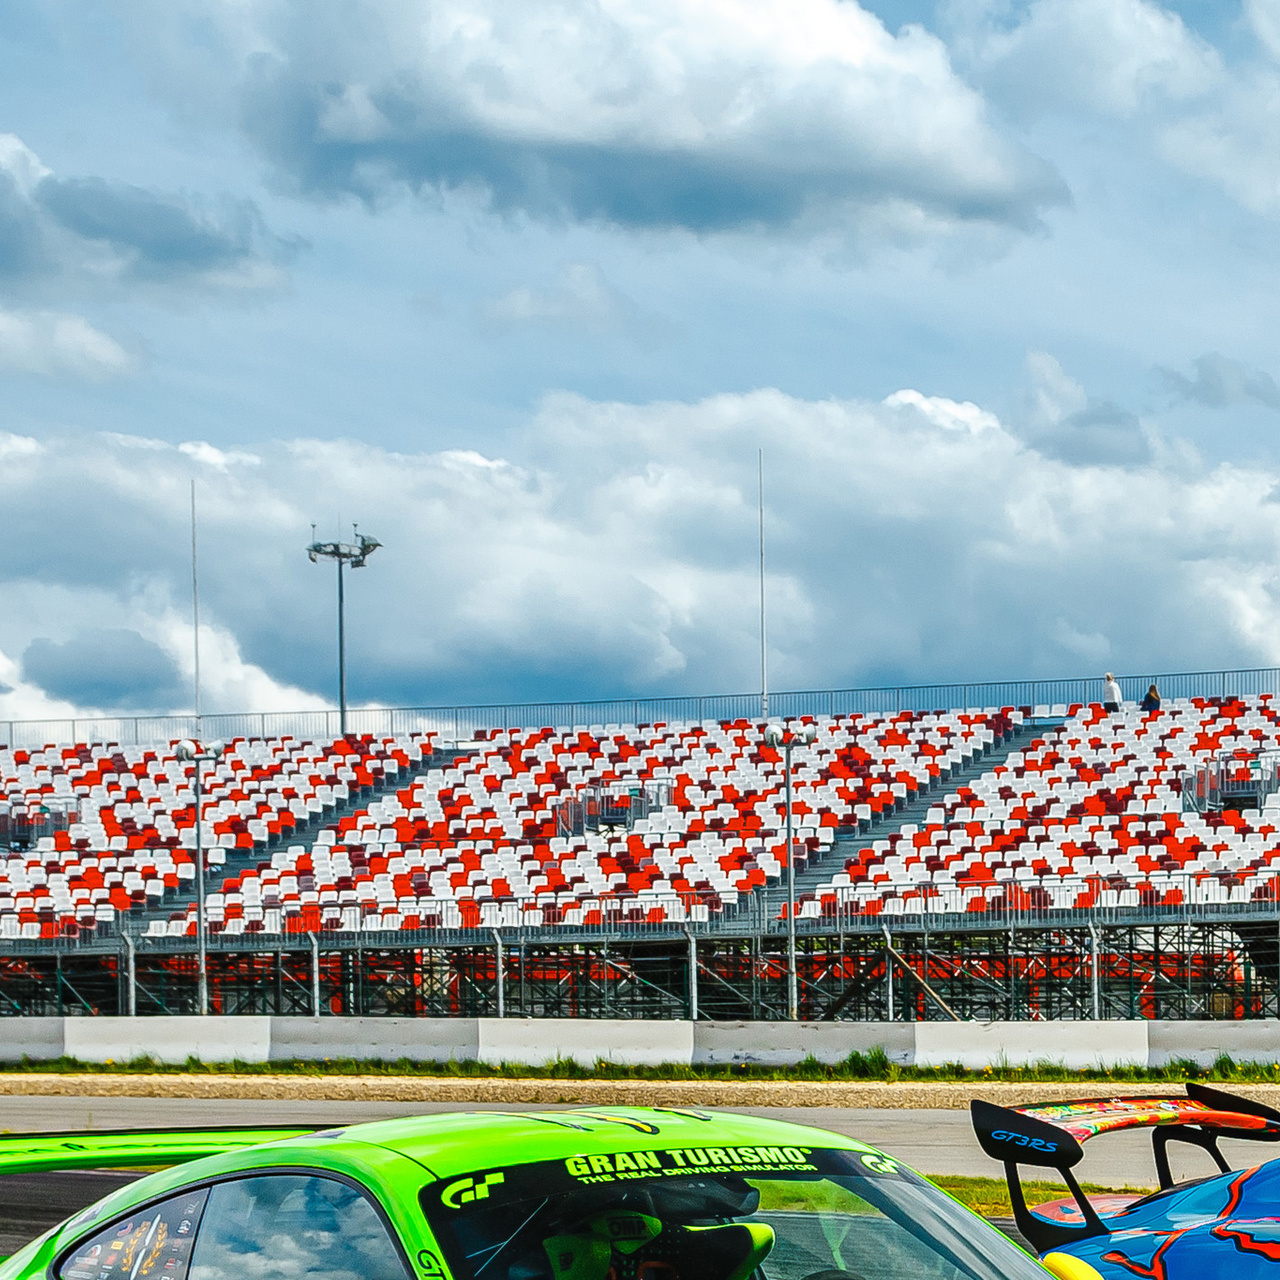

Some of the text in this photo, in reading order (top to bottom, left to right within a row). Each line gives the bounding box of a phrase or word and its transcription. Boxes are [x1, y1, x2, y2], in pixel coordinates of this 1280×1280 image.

[992, 1130, 1059, 1153] GT3RS
[565, 1151, 663, 1177] GRAN
[577, 1163, 818, 1186] THE REAL DRIVING SIMULATOR
